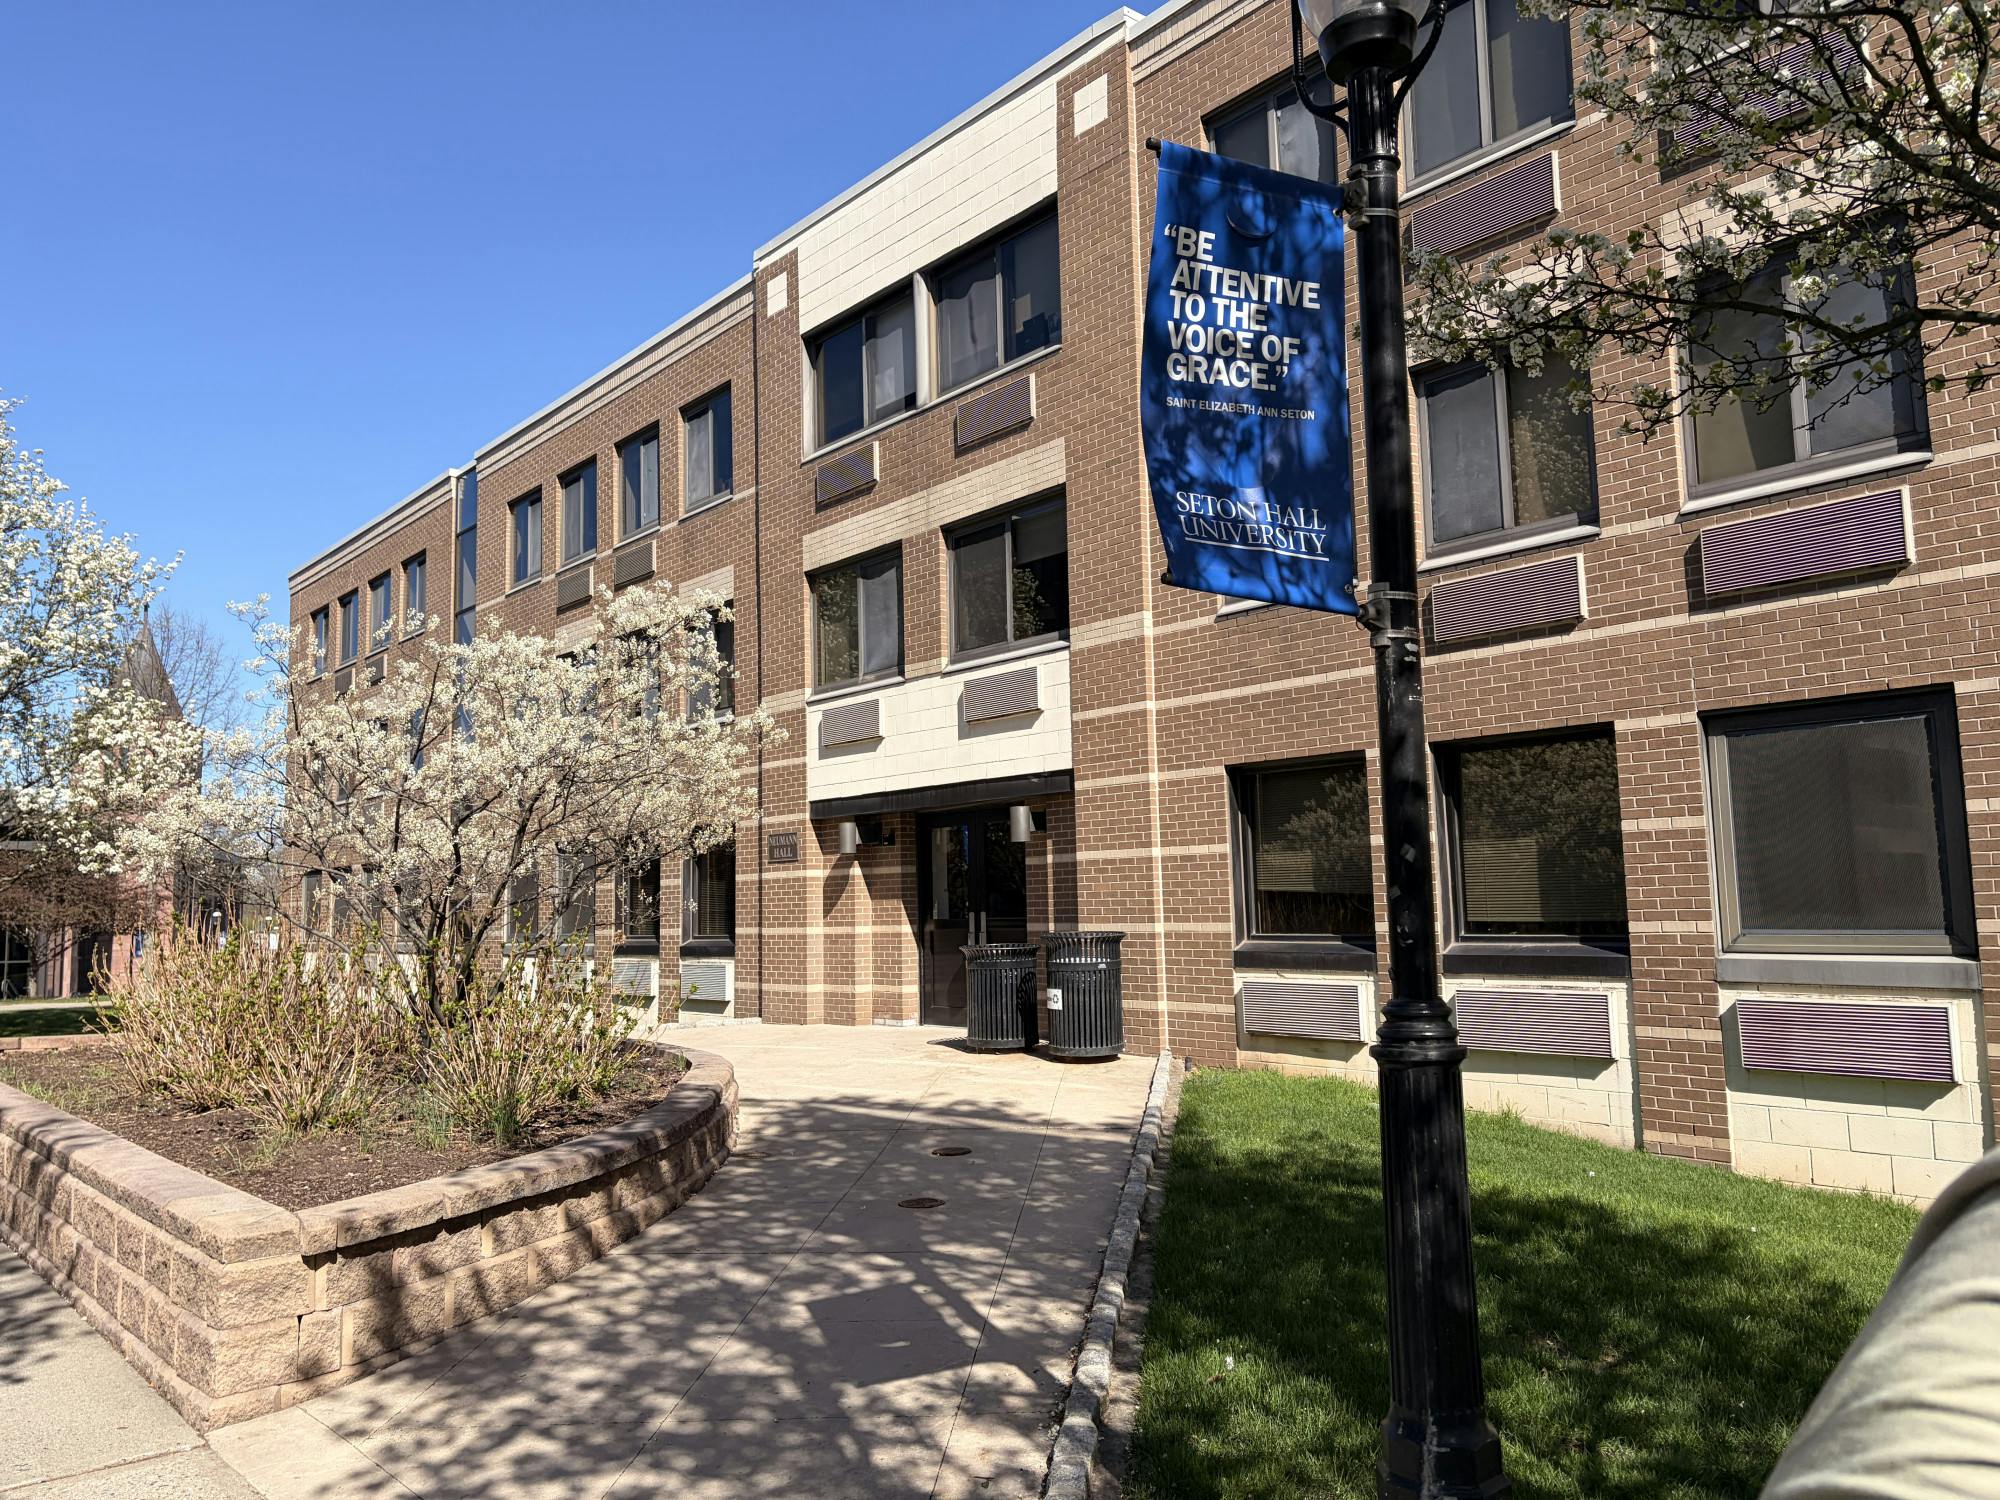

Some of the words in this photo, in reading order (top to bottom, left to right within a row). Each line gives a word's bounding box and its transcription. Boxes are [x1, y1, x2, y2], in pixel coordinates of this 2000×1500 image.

[1164, 223, 1216, 261] “BE
[1170, 259, 1320, 310] ATTENTIVE
[1169, 290, 1206, 322] TO
[1212, 297, 1268, 332] THE
[1167, 320, 1254, 360] VOICE
[1261, 335, 1300, 364] OF
[1166, 352, 1288, 392] GRACE.”
[1166, 396, 1197, 409] SAINT
[1199, 400, 1255, 415] ELIZABETH
[1257, 405, 1278, 418] ANN
[1280, 408, 1315, 420] SETON
[1176, 491, 1257, 521] SETON
[1264, 502, 1327, 531] HALL
[1178, 514, 1327, 554] UNIVERSITY
[774, 847, 793, 858] HALL
